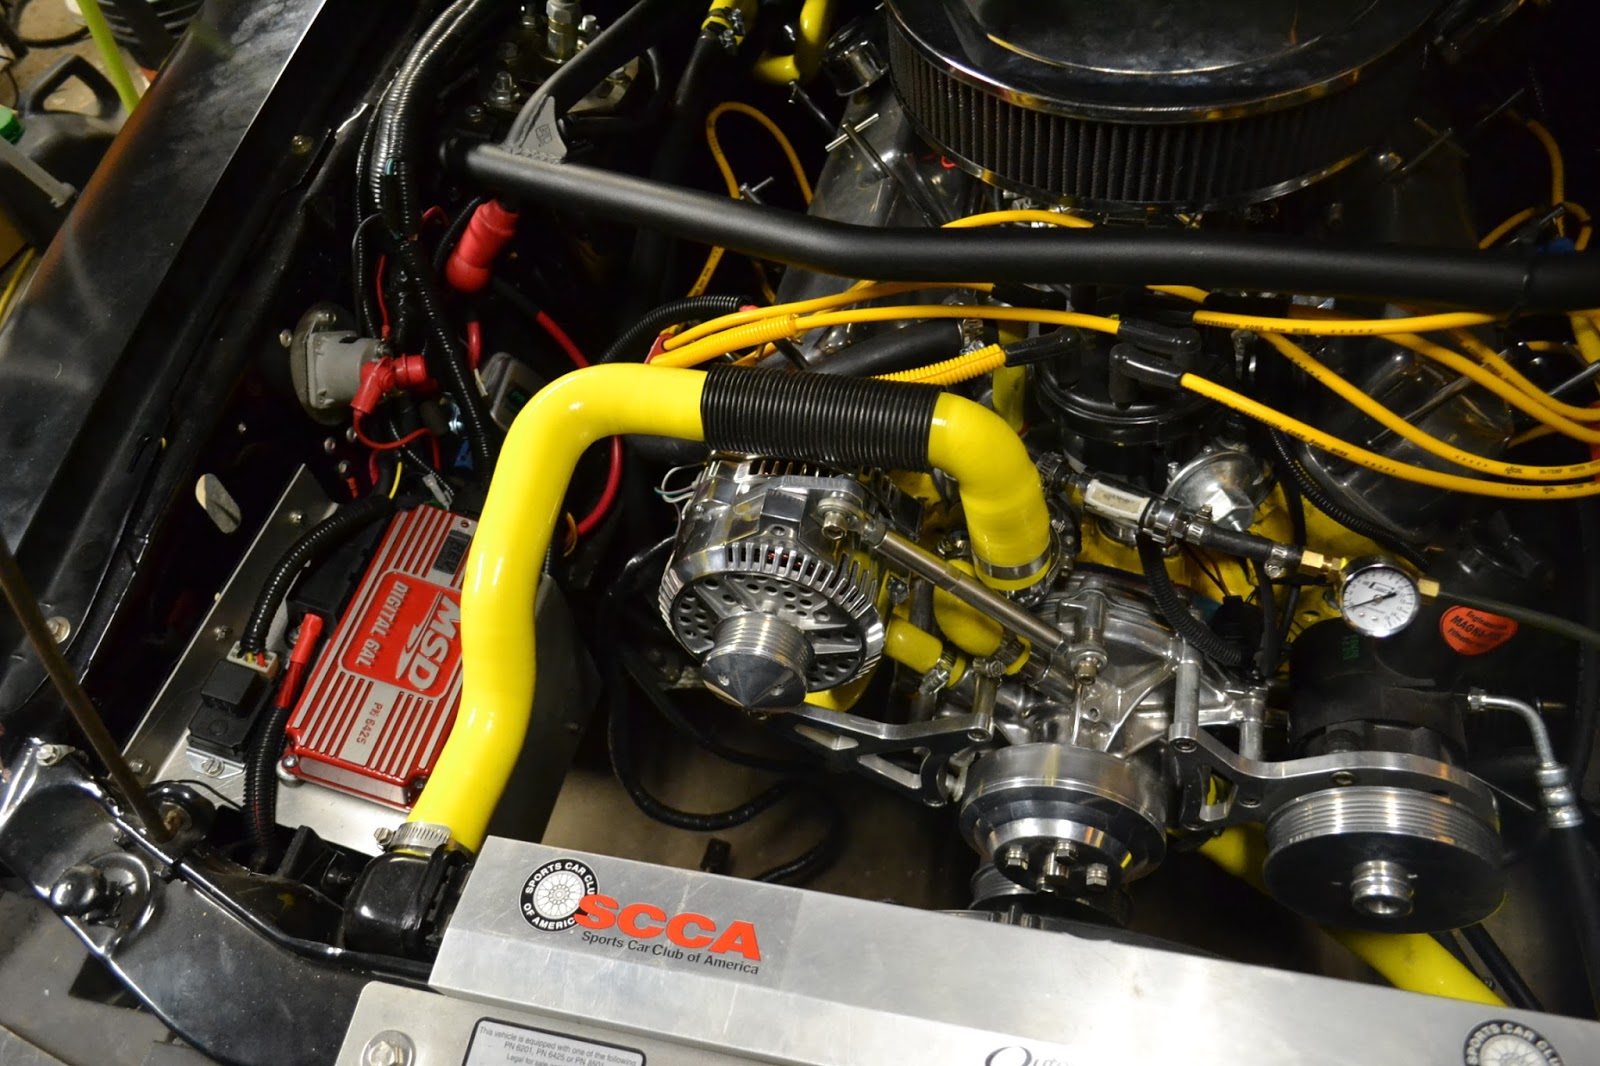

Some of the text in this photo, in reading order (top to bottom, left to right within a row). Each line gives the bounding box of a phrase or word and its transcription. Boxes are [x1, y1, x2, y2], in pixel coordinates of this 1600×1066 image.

[355, 580, 410, 668] DIGITAL 6AL
[408, 595, 462, 692] MSD
[356, 718, 376, 745] 6425
[525, 862, 597, 895] SPORTS CAR CLU
[523, 902, 576, 931] OF AMERIC
[573, 893, 762, 961] SCCA
[581, 930, 760, 975] Sports Car Club of America
[479, 1026, 493, 1036] This
[494, 1031, 517, 1041] vehicle
[525, 1038, 556, 1050] equipped
[557, 1045, 571, 1053] with
[594, 1052, 606, 1060] the
[606, 1054, 637, 1066] following
[504, 1041, 516, 1050] PN
[536, 1048, 547, 1057] PN
[548, 1052, 565, 1061] 6425
[575, 1056, 586, 1066] PN
[507, 1053, 525, 1064] Legal
